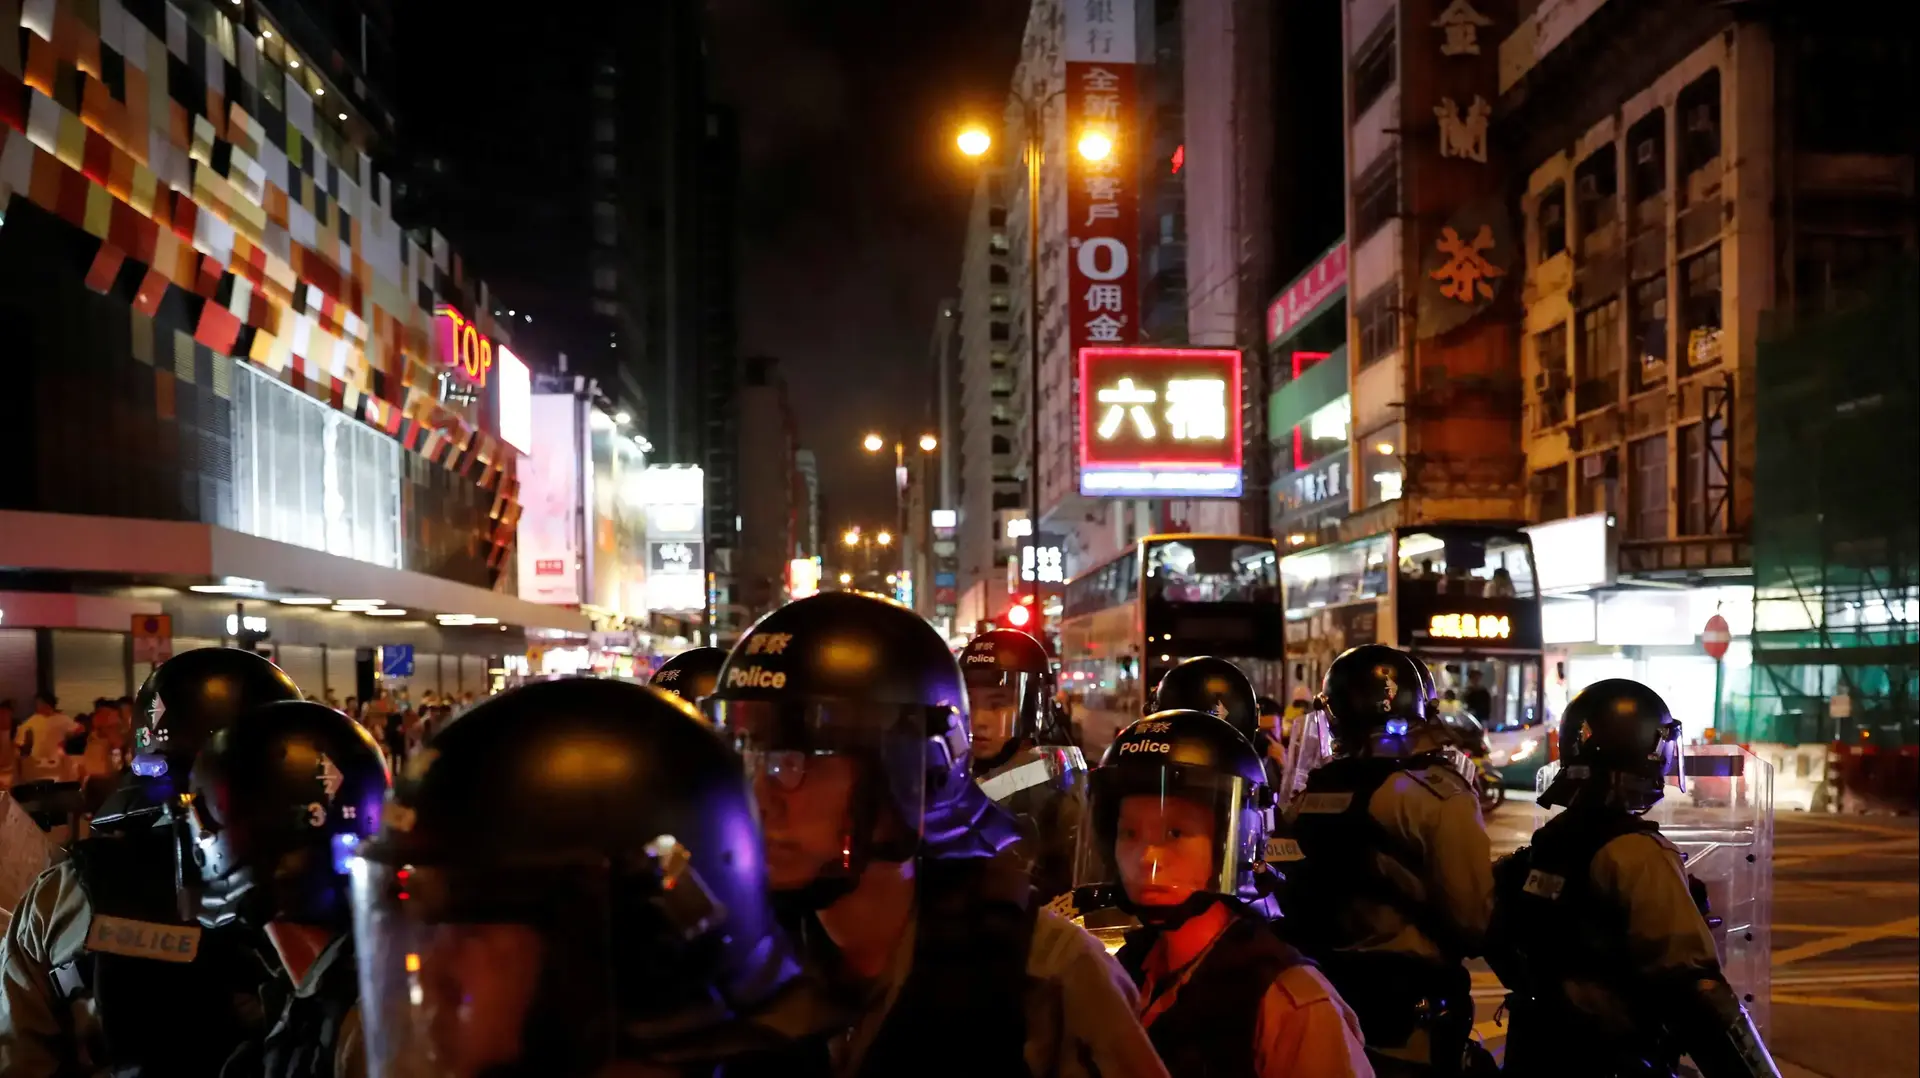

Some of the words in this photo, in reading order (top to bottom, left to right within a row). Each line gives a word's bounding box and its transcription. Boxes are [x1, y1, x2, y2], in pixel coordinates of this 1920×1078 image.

[437, 304, 492, 388] TOP
[1097, 378, 1226, 439] 六福
[966, 653, 996, 664] Police
[726, 665, 787, 689] Police
[142, 726, 151, 746] 3
[1119, 740, 1170, 756] Police
[307, 802, 327, 827] 3
[99, 923, 193, 954] POLICE
